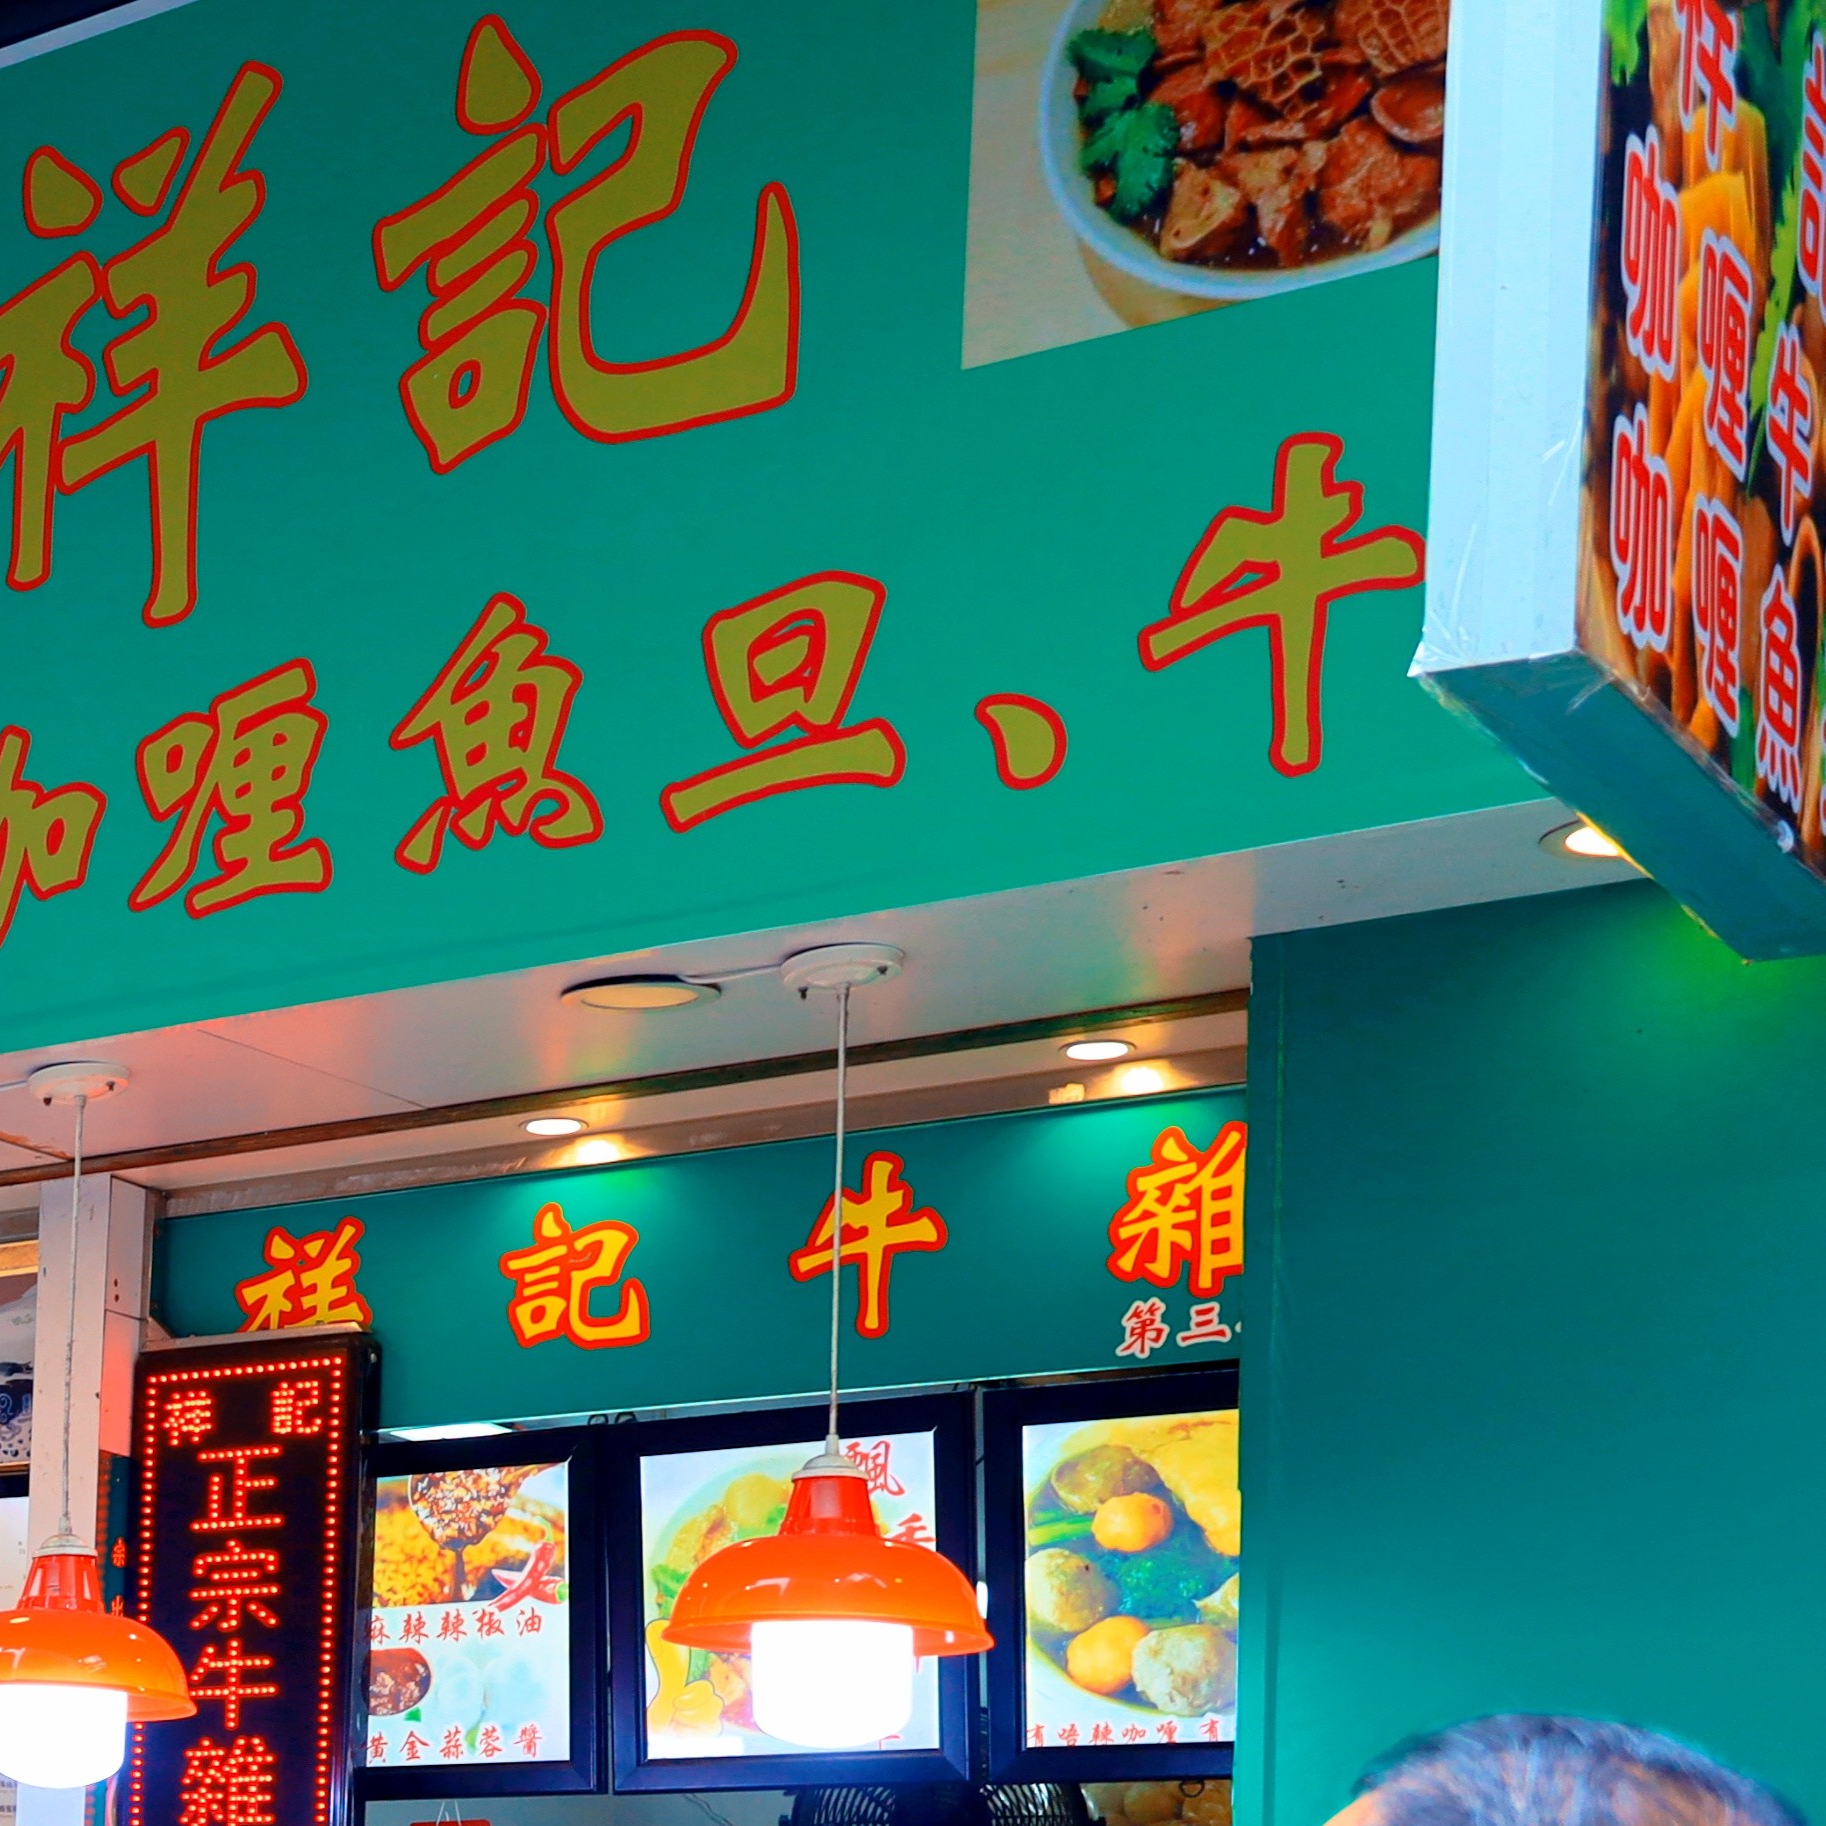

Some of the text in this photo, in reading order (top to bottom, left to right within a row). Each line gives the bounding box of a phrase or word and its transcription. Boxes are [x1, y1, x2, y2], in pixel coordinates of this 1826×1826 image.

[233, 1121, 1248, 1351] 祥記牛雜
[1117, 1300, 1241, 1358] 第三
[160, 1380, 322, 1448] 祥記
